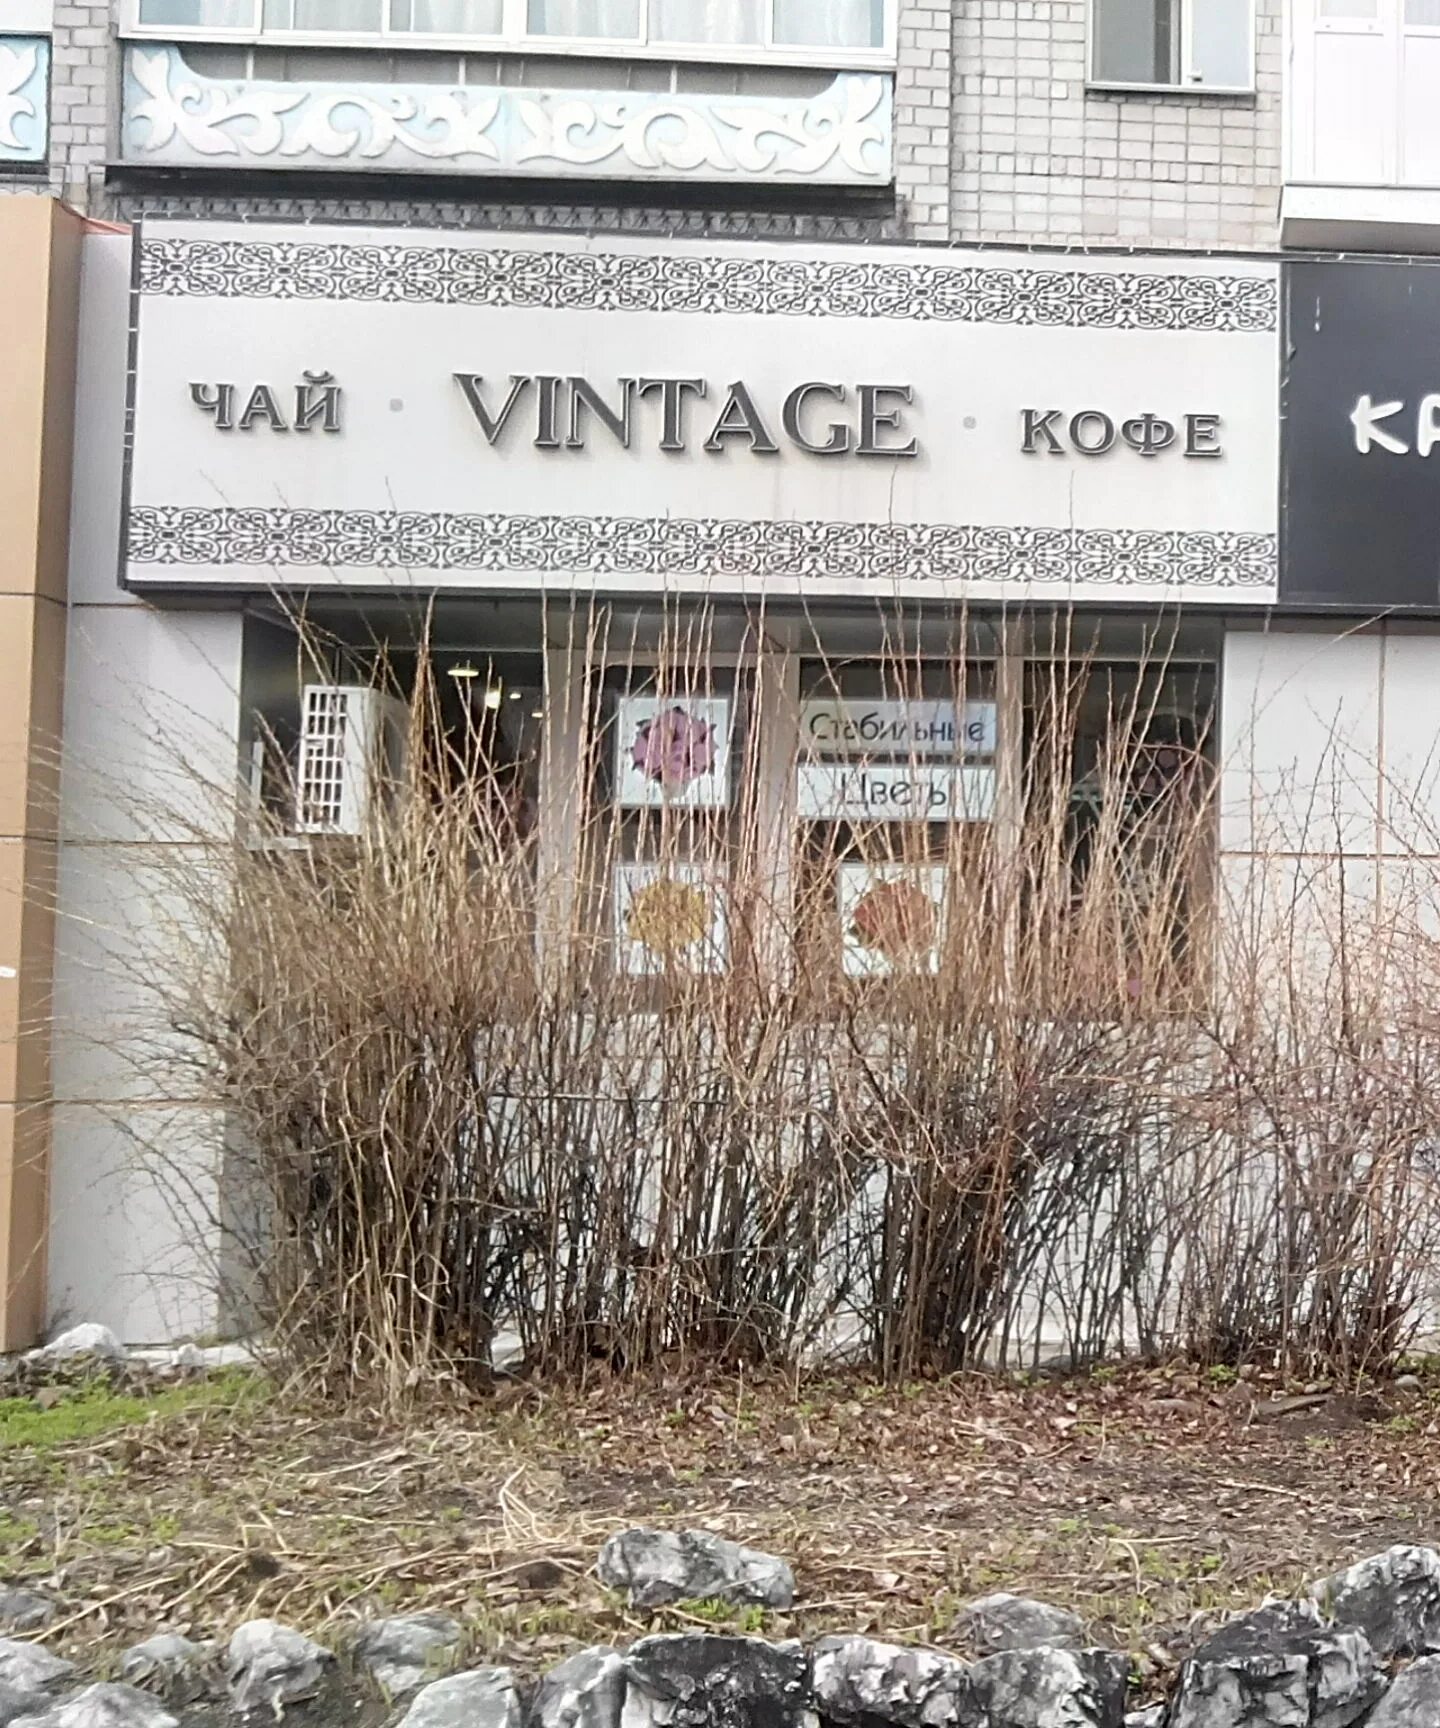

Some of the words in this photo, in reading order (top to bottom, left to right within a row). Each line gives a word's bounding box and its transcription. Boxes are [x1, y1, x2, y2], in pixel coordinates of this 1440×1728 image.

[190, 370, 341, 432] ЧАЙ
[452, 372, 918, 457] VINTAGE
[1019, 408, 1223, 457] КОФЕ
[809, 711, 985, 742] Стабильные
